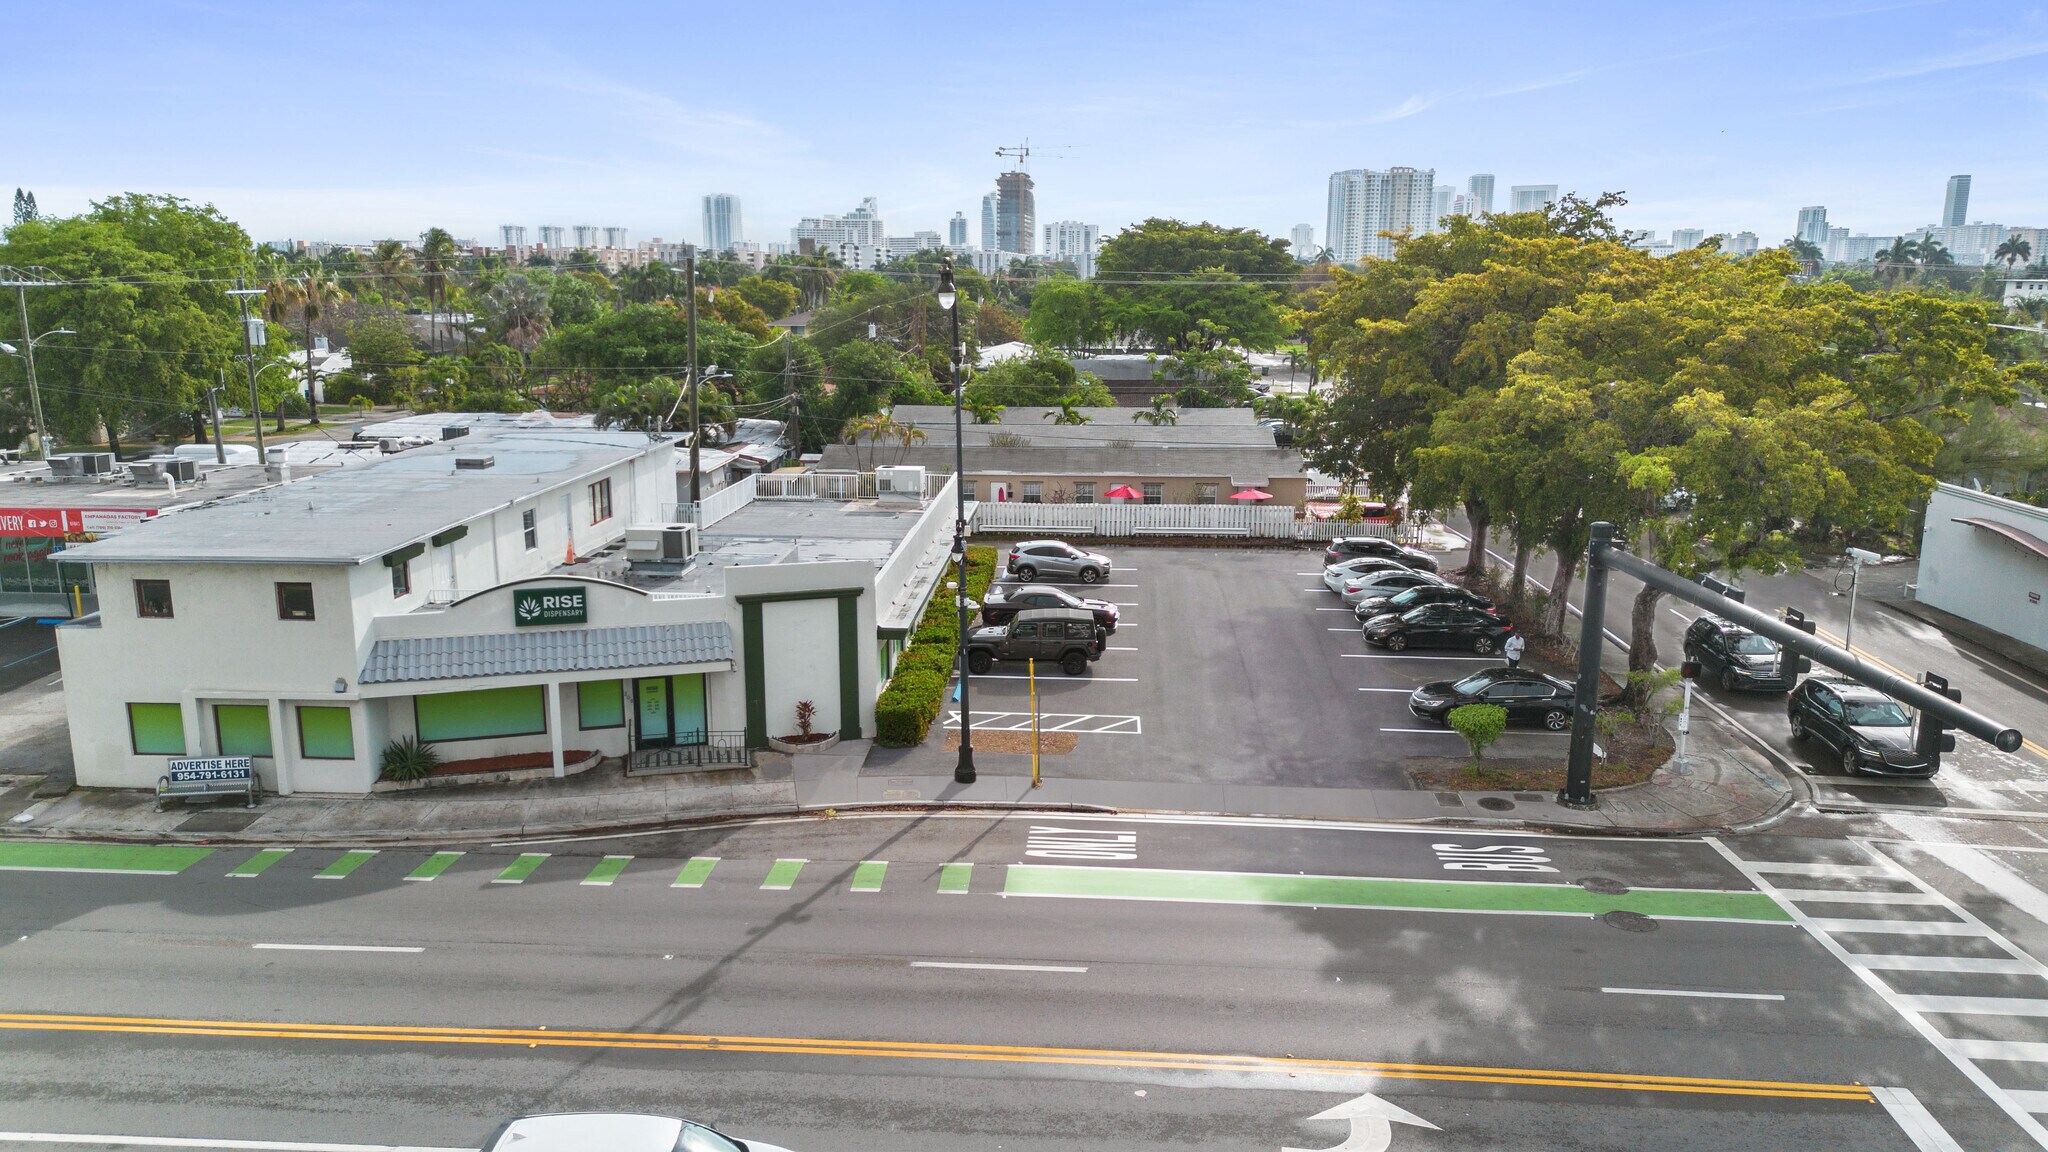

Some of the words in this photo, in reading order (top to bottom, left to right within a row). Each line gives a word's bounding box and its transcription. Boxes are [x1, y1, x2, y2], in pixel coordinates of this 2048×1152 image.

[543, 595, 583, 609] RISE
[543, 609, 584, 618] DISPENSARY
[171, 760, 222, 771] ADVERTISE
[225, 758, 250, 769] HERE
[177, 769, 245, 781] 954-791-6131
[1025, 825, 1138, 860] ONLY
[1431, 843, 1561, 873] BUS
